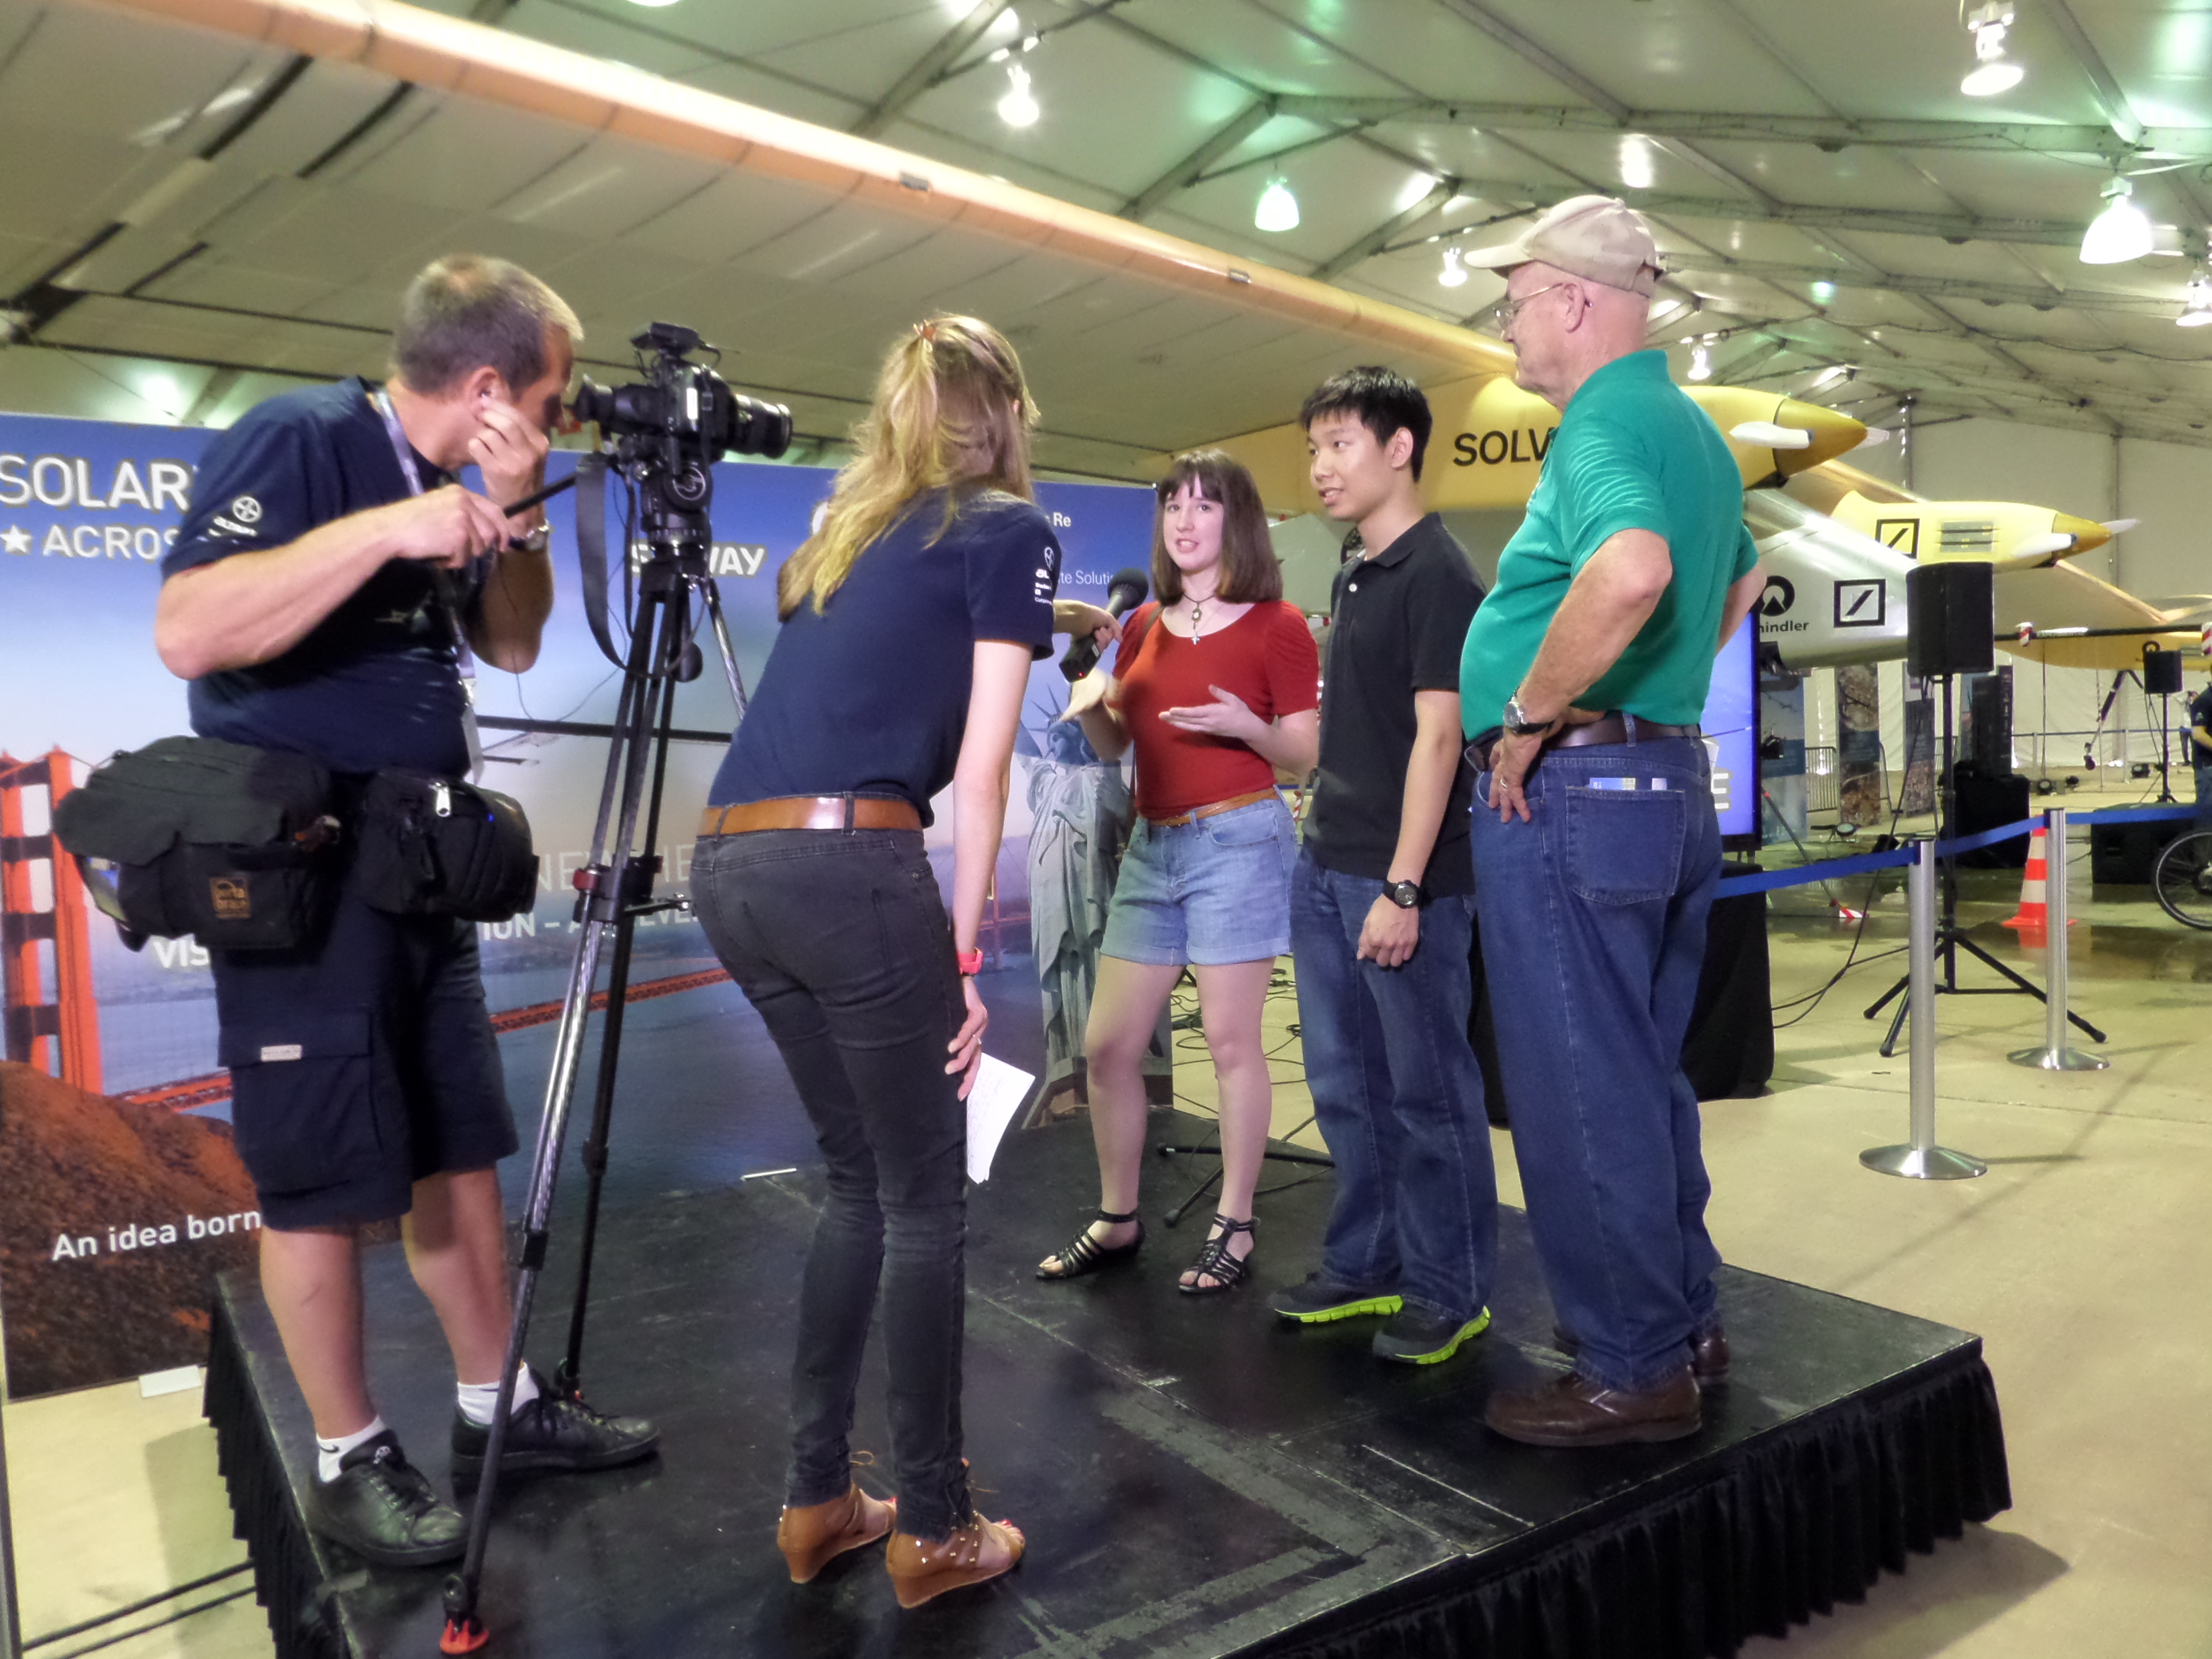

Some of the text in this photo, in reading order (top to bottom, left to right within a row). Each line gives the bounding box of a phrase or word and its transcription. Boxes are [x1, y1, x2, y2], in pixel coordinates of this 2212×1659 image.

[0, 454, 190, 511] SOLAR
[1053, 512, 1071, 527] Re
[1075, 569, 1113, 585] Soluti
[53, 1210, 261, 1262] An idea born
